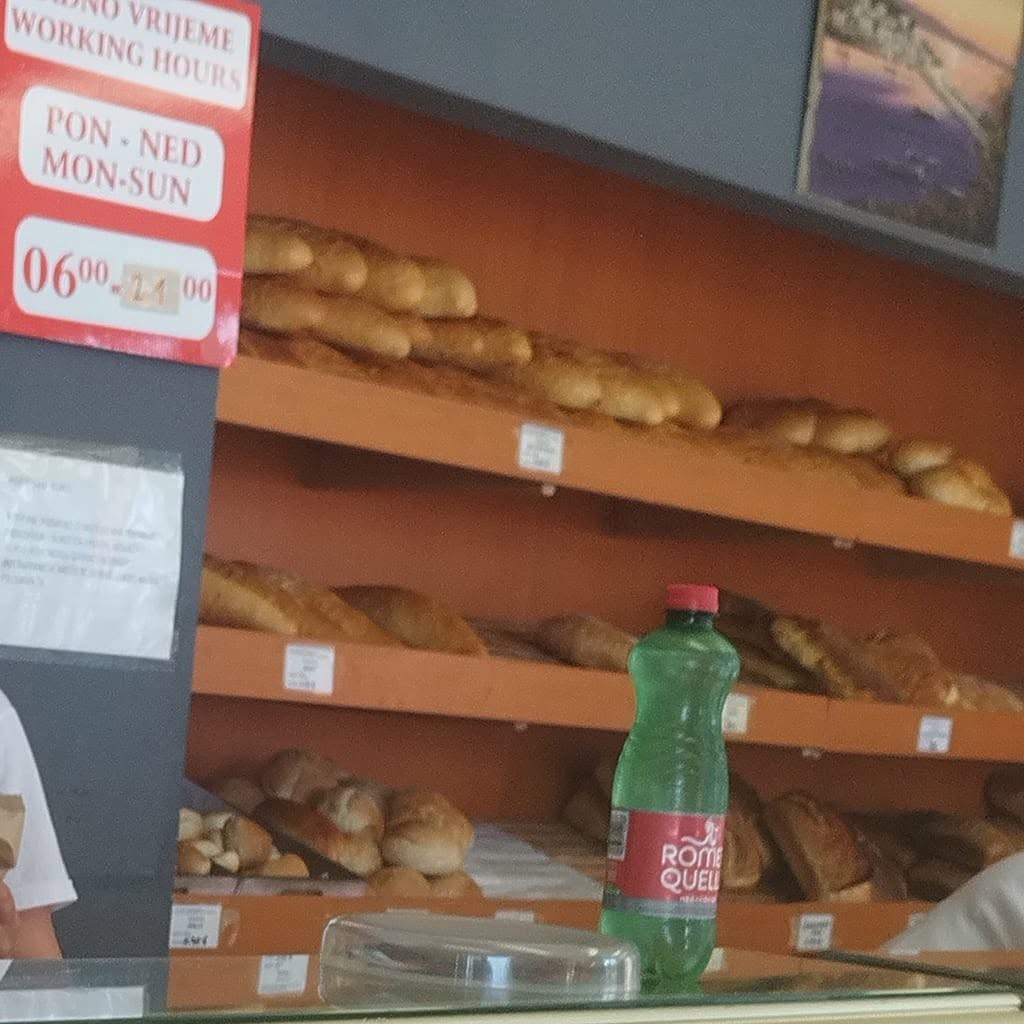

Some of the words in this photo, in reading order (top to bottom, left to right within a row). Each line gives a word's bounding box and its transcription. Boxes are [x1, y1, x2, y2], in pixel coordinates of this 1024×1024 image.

[11, 8, 143, 67] WORKING
[153, 48, 242, 92] HOURS
[129, 3, 235, 54] VRIJEME
[45, 104, 112, 148] PON
[139, 127, 203, 168] NED
[42, 147, 192, 206] MON-SUN
